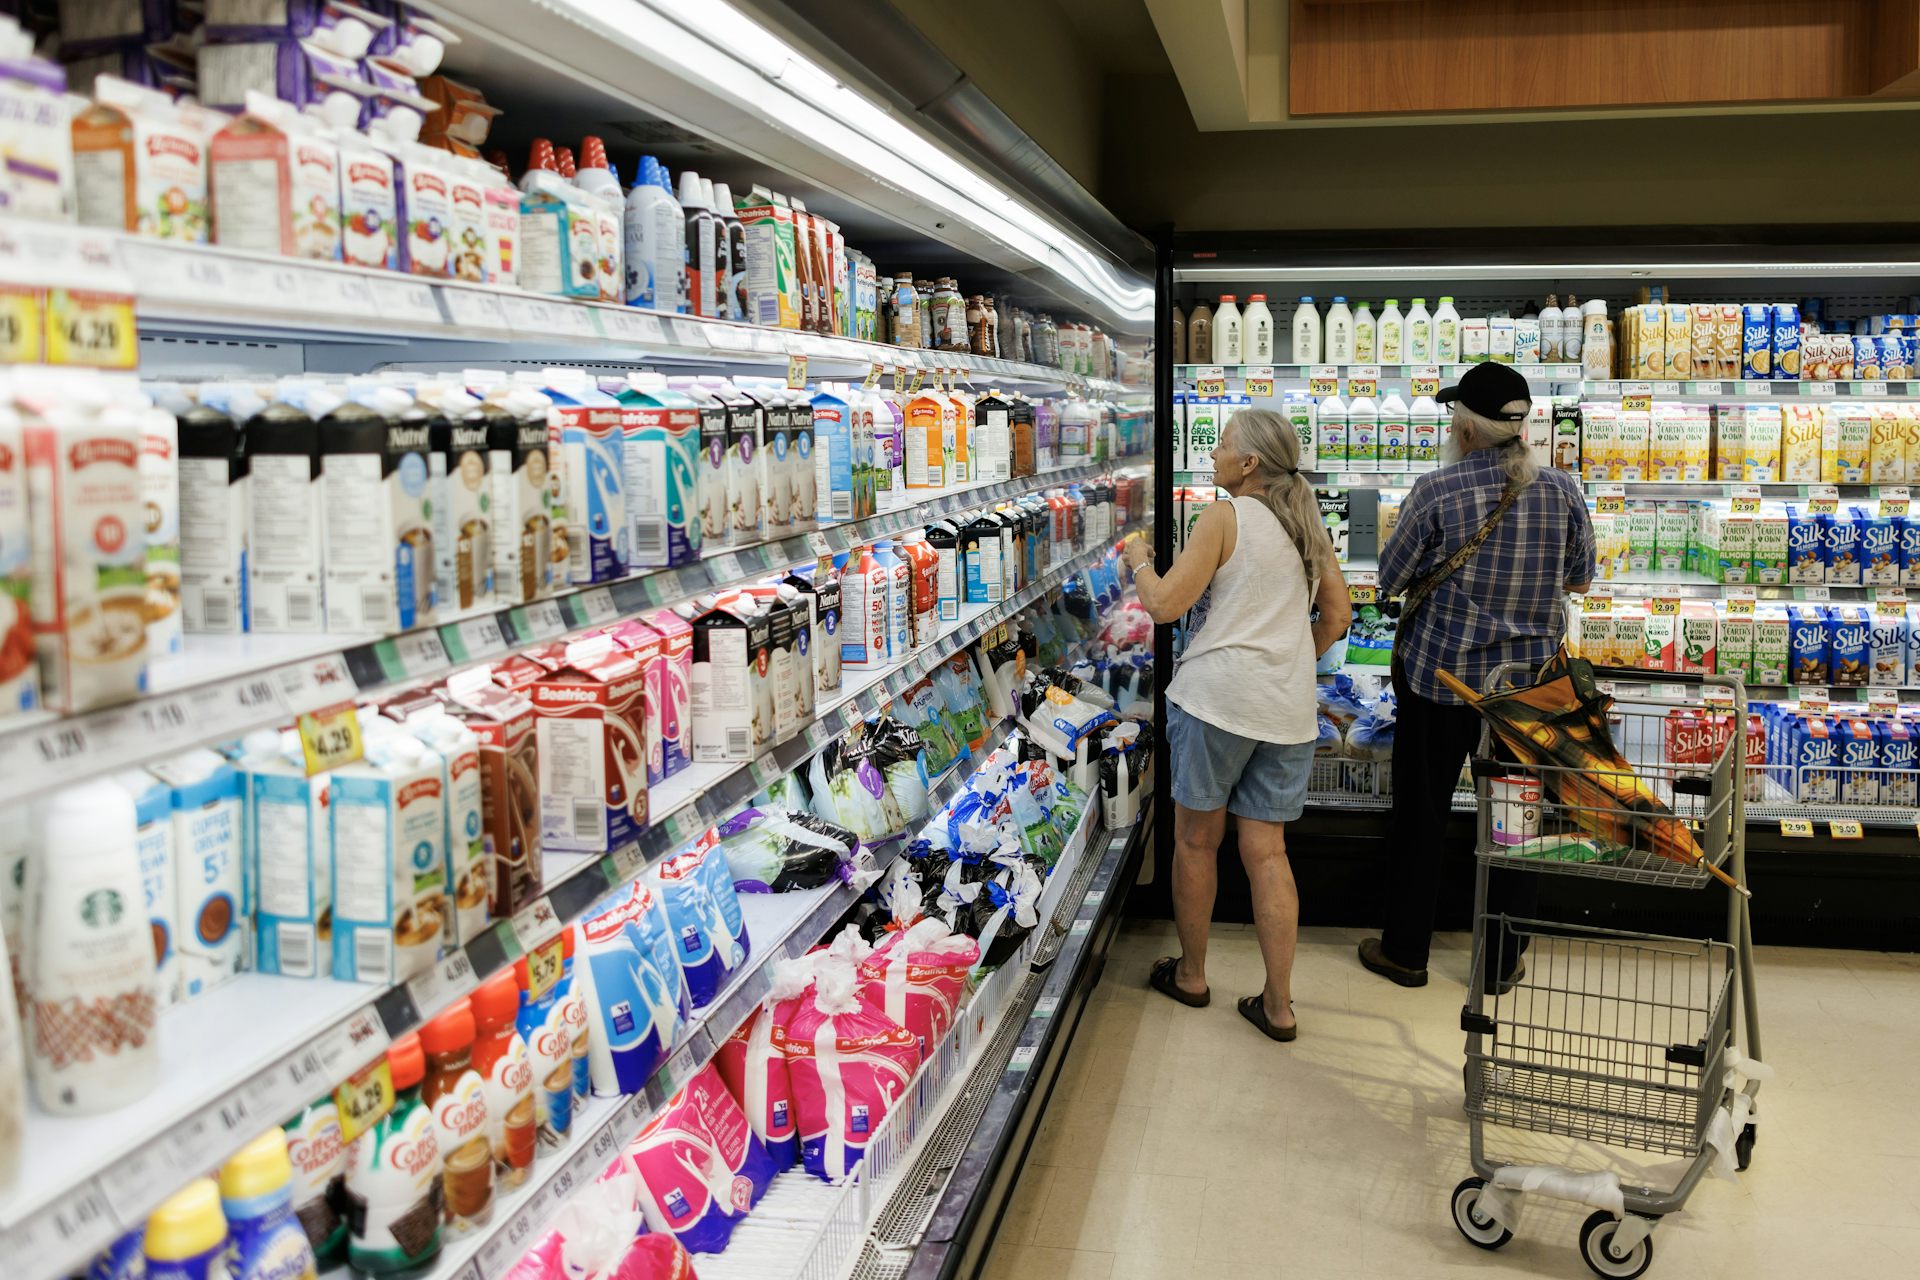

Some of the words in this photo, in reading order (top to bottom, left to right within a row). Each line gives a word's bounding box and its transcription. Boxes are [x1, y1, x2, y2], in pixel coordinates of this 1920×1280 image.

[1516, 332, 1539, 346] Silk
[1692, 322, 1717, 339] Silk
[1717, 322, 1743, 339] Silk
[1745, 325, 1771, 342] Silk
[1775, 325, 1800, 342] Silk
[1803, 345, 1827, 360] Silk
[1829, 344, 1853, 360] Silk
[1856, 347, 1879, 361] Silk
[1881, 348, 1904, 361] Silk
[1191, 427, 1216, 435] GRASS
[1786, 423, 1822, 445] Silk
[1872, 422, 1906, 445] Silk
[1191, 435, 1216, 445] FED
[1320, 502, 1347, 511] Natrel
[1789, 522, 1826, 548] Silk
[1825, 523, 1862, 548] Silk
[1863, 525, 1900, 550] Silk
[1719, 552, 1751, 560] ALMOND
[1754, 552, 1787, 560] ALMOND
[819, 591, 840, 608] Natrel
[1793, 625, 1829, 650] Silk
[1832, 625, 1871, 650] Silk
[1869, 626, 1906, 649] Silk
[1755, 653, 1787, 661] ALMOND
[537, 687, 599, 702] Beatrice
[1800, 738, 1838, 764] Silk
[1843, 740, 1881, 765] Silk
[1880, 741, 1919, 766] Silk
[1784, 823, 1807, 831] $2.99
[593, 1132, 612, 1158] 6.99
[553, 1172, 573, 1199] 6.99
